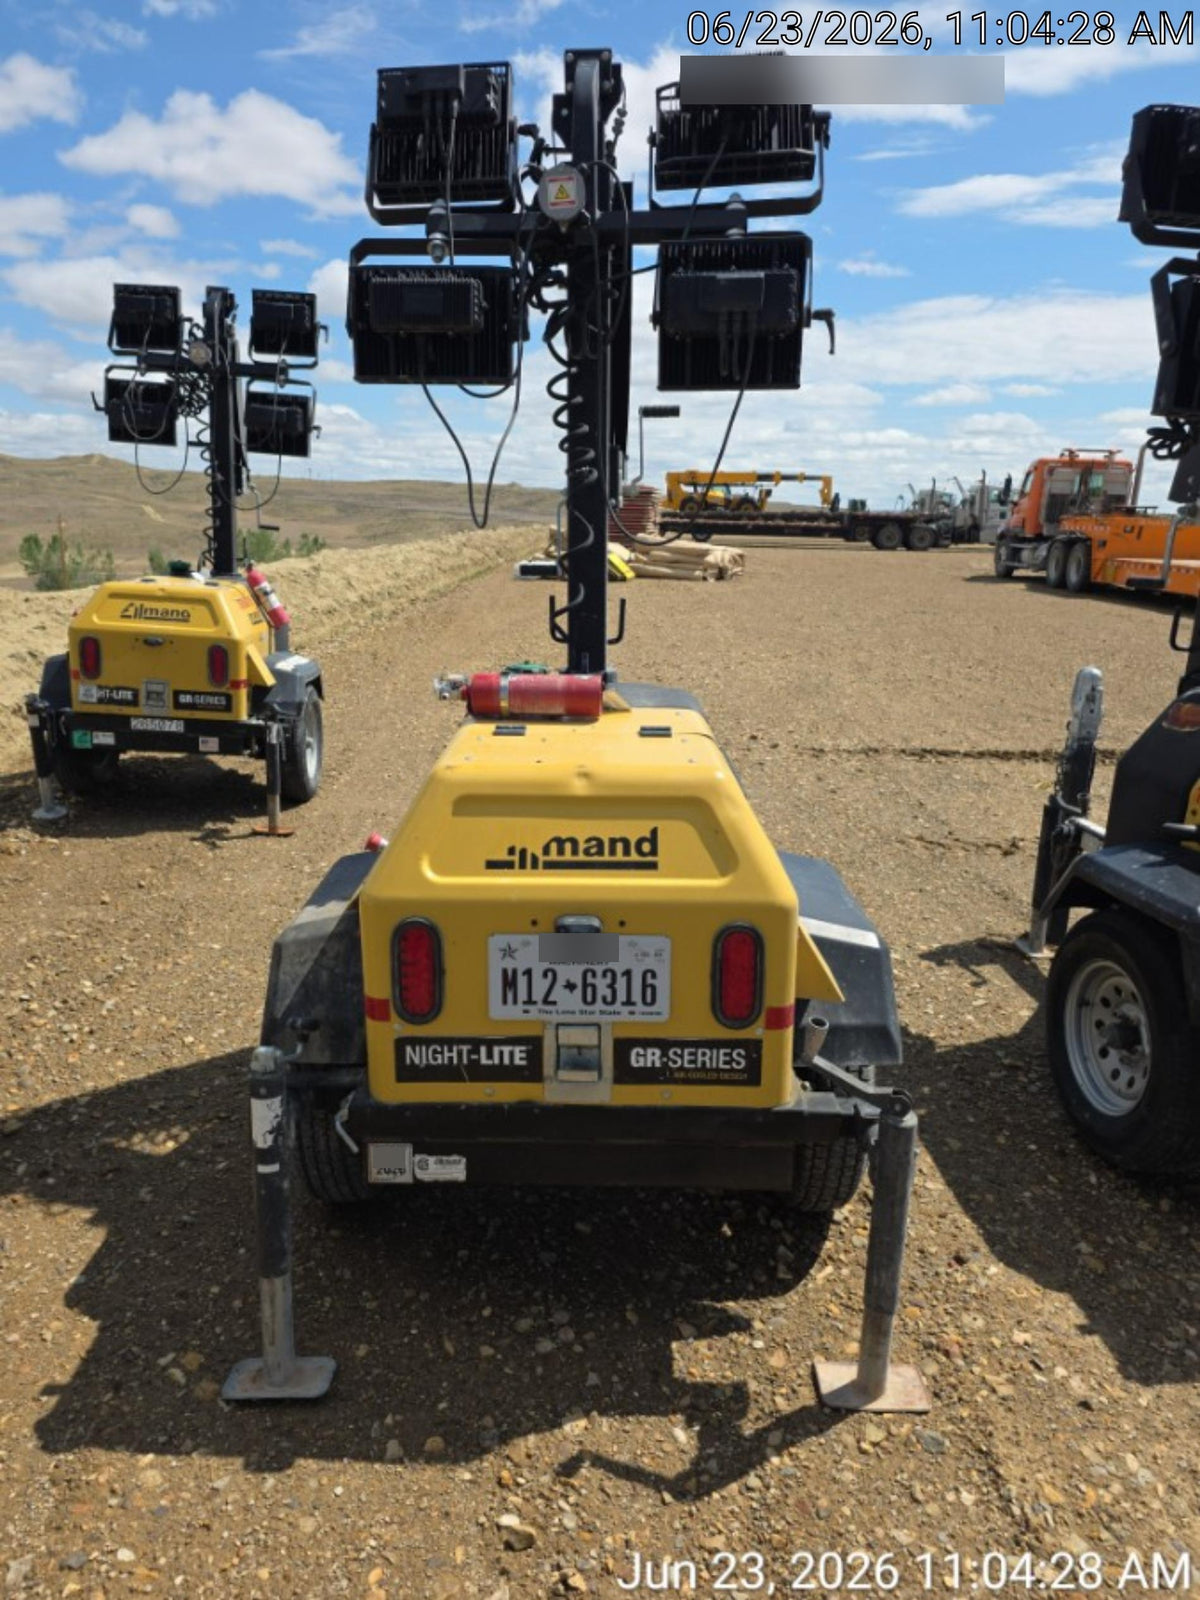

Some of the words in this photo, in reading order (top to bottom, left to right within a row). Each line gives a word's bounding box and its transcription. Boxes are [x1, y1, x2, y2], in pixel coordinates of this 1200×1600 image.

[501, 967, 558, 1006] M12
[581, 968, 657, 1007] 6316
[404, 1045, 528, 1066] NIGHT-LITE
